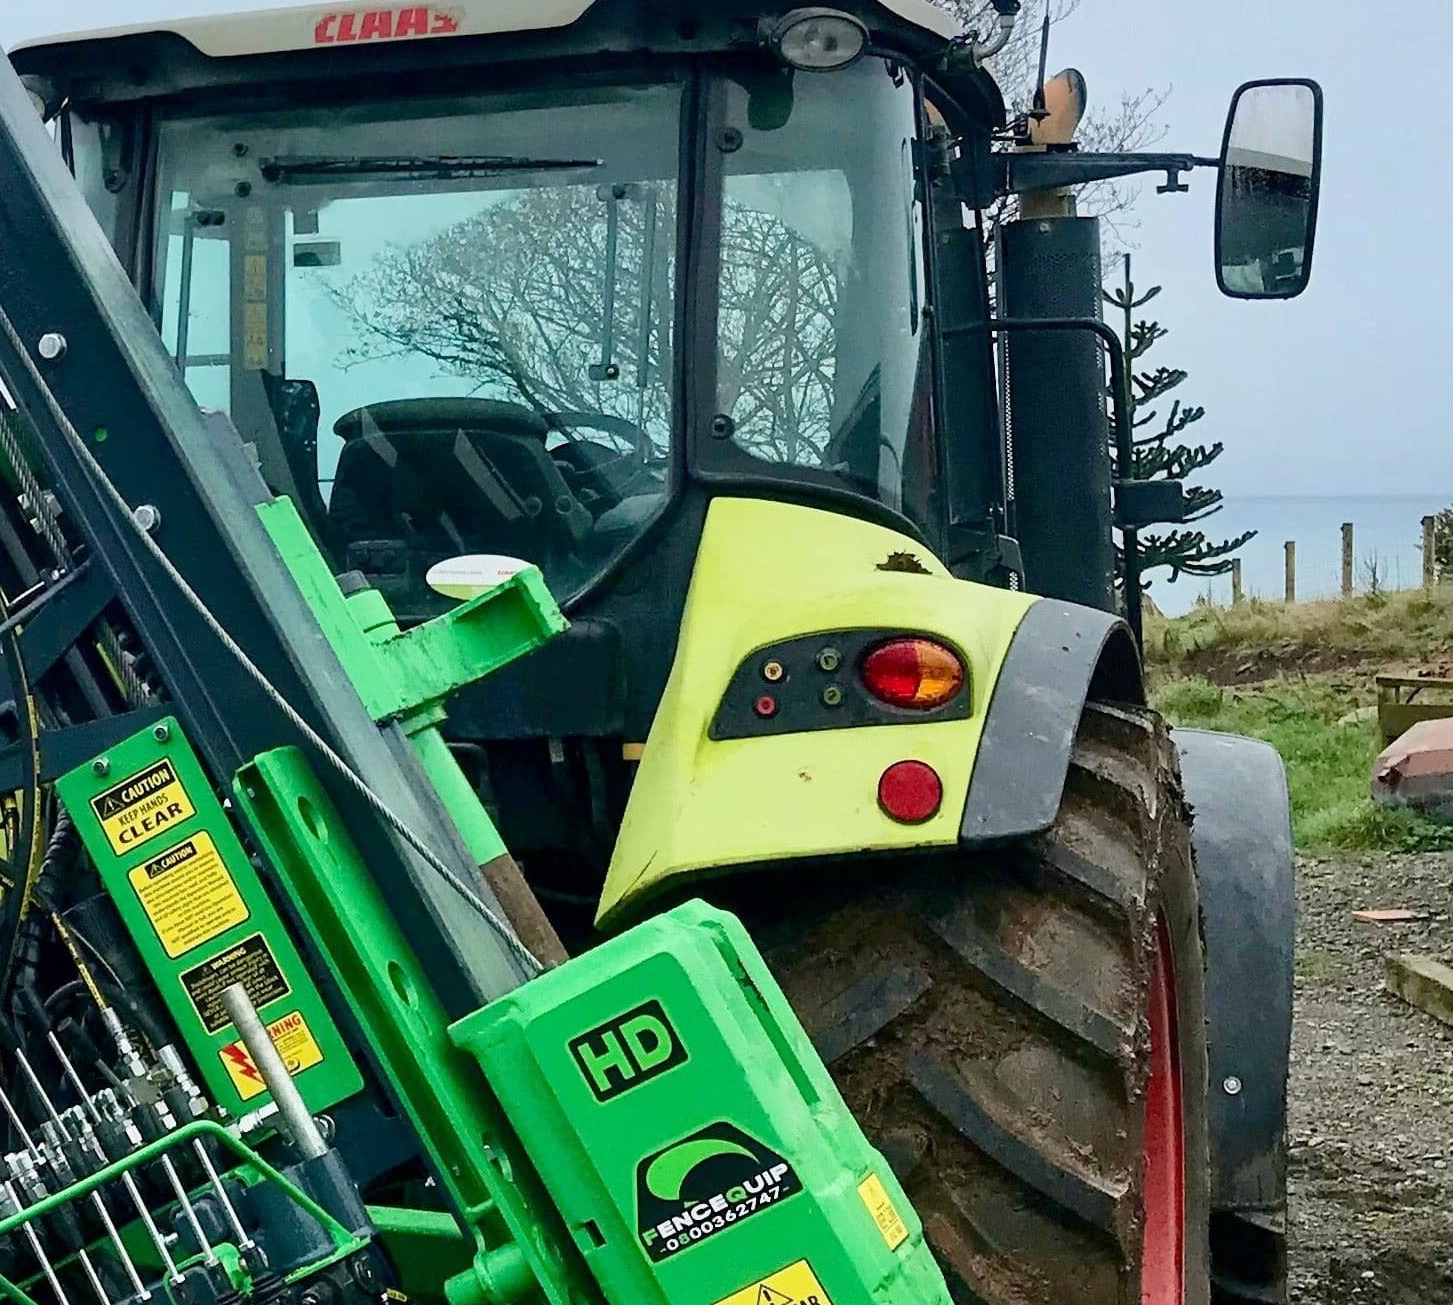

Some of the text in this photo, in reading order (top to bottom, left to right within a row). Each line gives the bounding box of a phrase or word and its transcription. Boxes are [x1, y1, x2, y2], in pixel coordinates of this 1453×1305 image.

[314, 7, 459, 44] CLAAS
[121, 768, 170, 803] CAUTION
[118, 792, 169, 826] KEEP HANDS
[118, 802, 183, 844] CLEAR
[160, 845, 194, 869] CAUTION
[268, 1014, 301, 1038] NING
[577, 1014, 673, 1093] HD
[642, 1162, 789, 1247] FENCEQUIP
